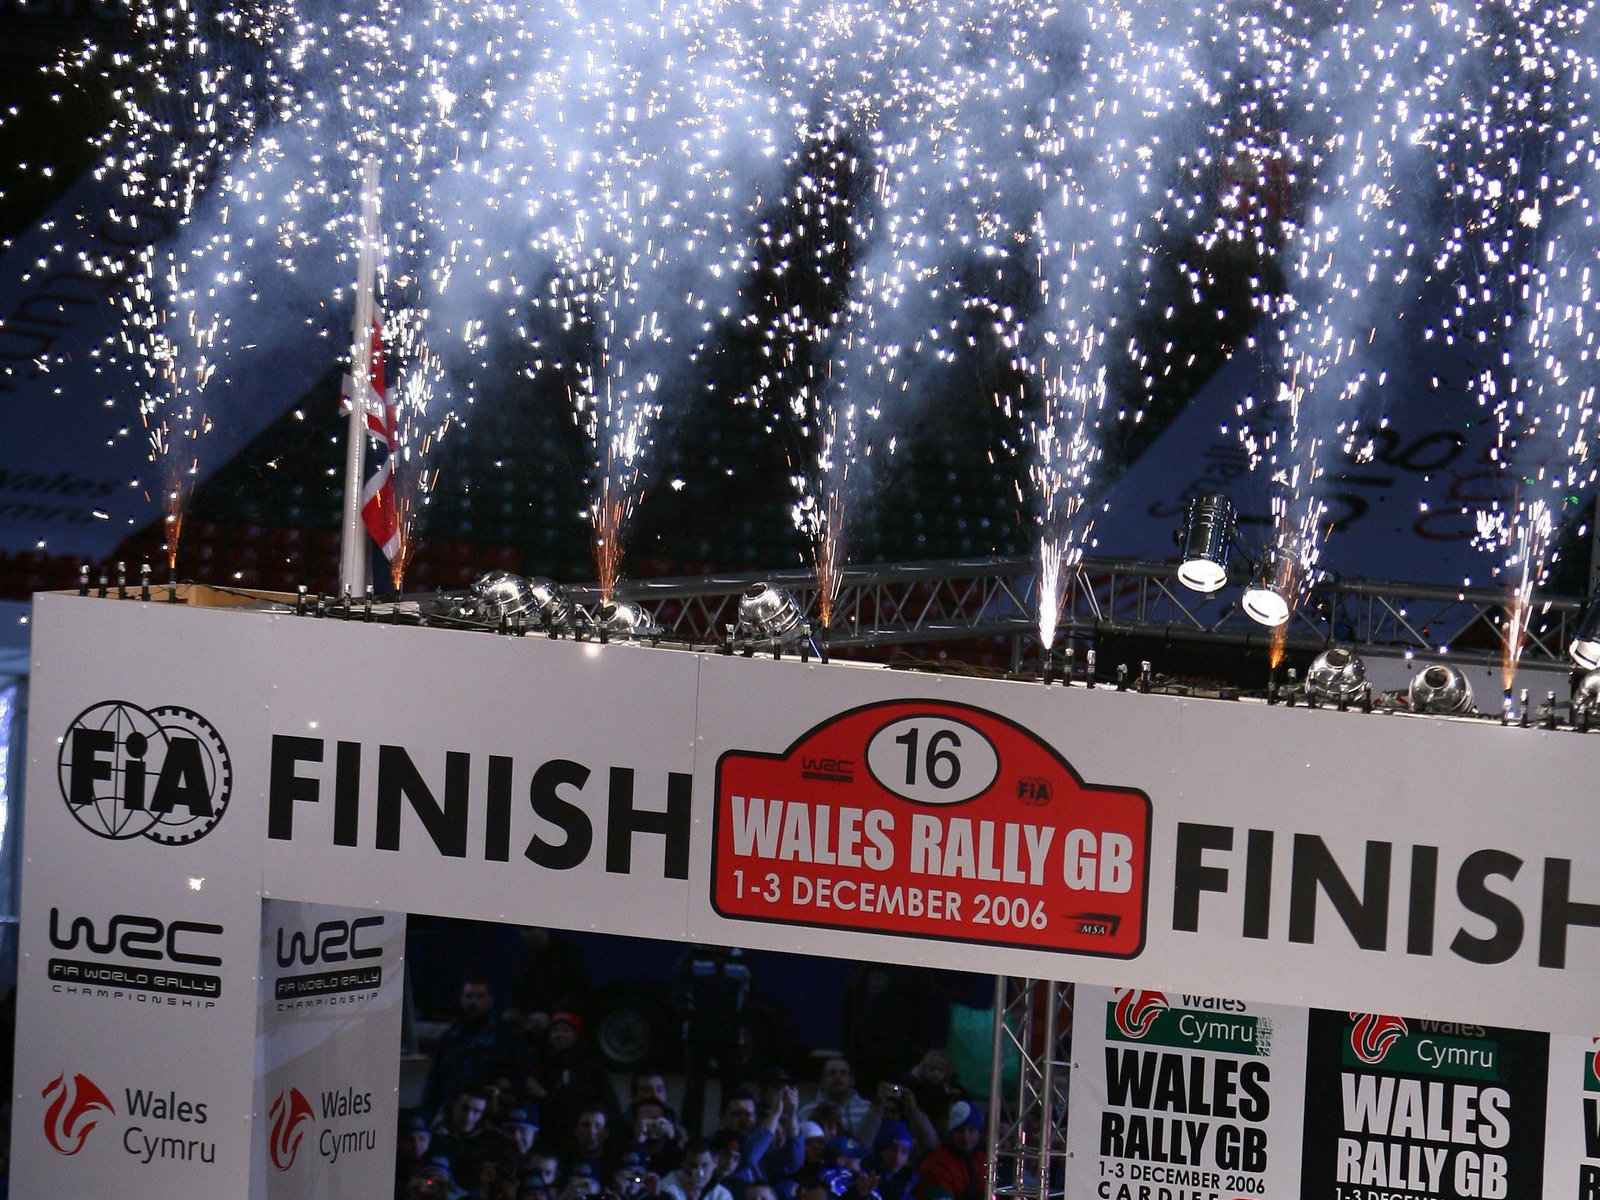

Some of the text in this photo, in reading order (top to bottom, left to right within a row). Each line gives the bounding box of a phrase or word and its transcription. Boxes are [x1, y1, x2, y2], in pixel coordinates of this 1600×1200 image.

[895, 727, 962, 790] 16
[268, 734, 693, 880] FINISH
[731, 795, 1133, 894] WALES RALLY GB
[733, 870, 1048, 931] 1-3 DECEMBER 2006
[1172, 822, 1600, 970] FINISH
[50, 907, 224, 967] WRC
[277, 915, 385, 968] WRC
[1081, 924, 1106, 936] MSA
[52, 984, 216, 1009] CHAMPIONSHIP
[53, 964, 216, 992] FIA WORLD RALLY
[278, 972, 379, 994] FIA WORLD RALLY
[277, 992, 378, 1012] CHAMPIONSHIP
[1179, 1014, 1253, 1043] Cymru
[1417, 1039, 1493, 1069] Cymru
[321, 1086, 372, 1119] Wales
[1105, 1046, 1271, 1123] WALES
[125, 1087, 208, 1124] Wales
[1341, 1072, 1511, 1149] WALES
[123, 1127, 215, 1164] Cymru
[319, 1127, 376, 1163] Cymru
[1100, 1111, 1268, 1174] RALLY GB
[1099, 1160, 1265, 1195] 1-3 DECEMBER 2006
[1336, 1137, 1508, 1200] RALLY GB
